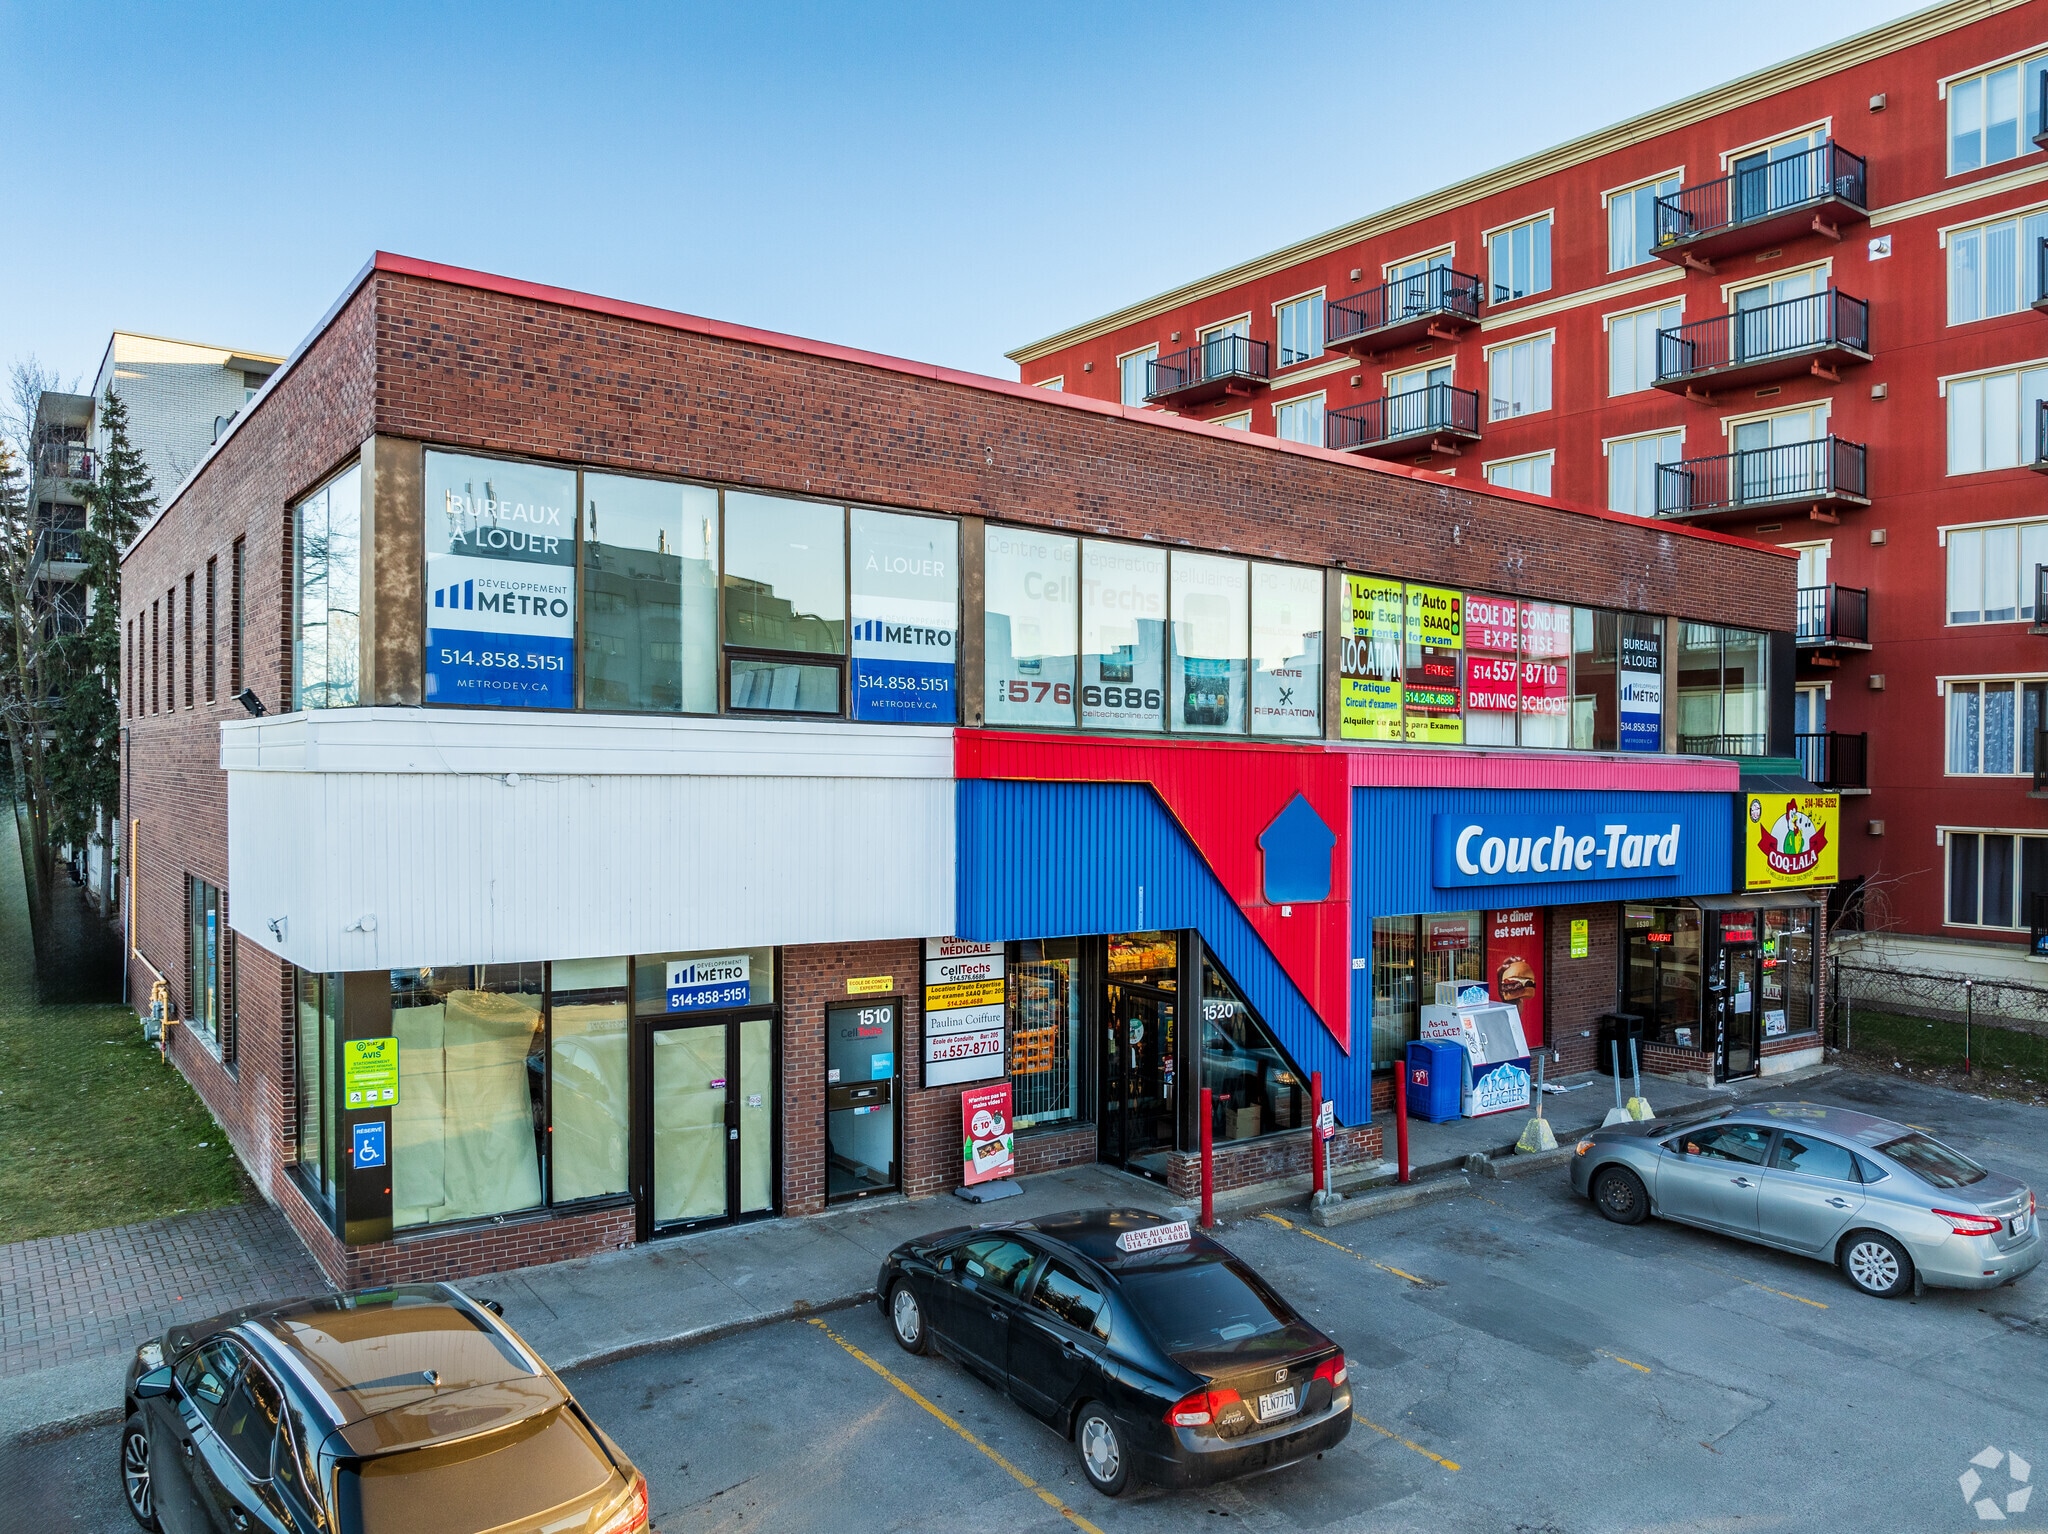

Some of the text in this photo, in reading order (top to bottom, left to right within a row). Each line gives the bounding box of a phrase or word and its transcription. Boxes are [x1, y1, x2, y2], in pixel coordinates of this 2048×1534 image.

[450, 495, 560, 527] BUREAUX
[450, 518, 559, 555] À LOUER
[865, 550, 945, 577] À LOUER
[987, 535, 1047, 559] Centre
[1054, 545, 1073, 562] de
[1083, 551, 1164, 574] réparation
[1173, 568, 1242, 589] cellulaires
[1290, 578, 1319, 594] MAC
[478, 578, 567, 594] DÉVELOPPEMENT
[478, 592, 569, 618] MÉTRO
[1413, 592, 1447, 611] d'Auto
[1352, 608, 1375, 622] pour
[1423, 615, 1450, 632] SAAQ
[1466, 597, 1570, 635] ÉCOLE DE CONDUITE
[886, 625, 952, 647] MÉTRO
[1352, 626, 1452, 646] car rental for exam
[1484, 629, 1554, 653] EXPERTISE
[1623, 638, 1658, 653] BUREAUX
[440, 648, 565, 671] 514.858.5151
[1341, 637, 1401, 679] LOCATION
[1624, 652, 1658, 669] À LOUER
[1270, 668, 1303, 678] VENTE
[1425, 663, 1455, 678] ERTISE
[1473, 660, 1558, 685] 514 557-8710
[457, 678, 549, 693] METRODEV.CA
[859, 674, 949, 692] 514.858.5151
[1352, 680, 1391, 695] Pratique
[1008, 680, 1071, 705] 576
[1082, 685, 1161, 710] 6686
[1345, 696, 1398, 711] Circuit d'examen
[1469, 691, 1567, 712] DRIVING SCHOOL
[1632, 688, 1660, 704] MÉTRO
[871, 700, 938, 710] METRODEV.CA
[1082, 709, 1160, 721] celltechsonline.com
[1343, 716, 1375, 730] Alquiler
[1411, 721, 1429, 731] para
[1430, 722, 1460, 732] Examen
[1620, 721, 1658, 734] 514.858.5151
[1390, 730, 1416, 739] SAAQ
[1455, 823, 1681, 876] Couche-Tard
[1768, 848, 1818, 873] COQ-LALA
[1496, 909, 1534, 924] Le dîner
[1494, 924, 1536, 939] est servi.
[1636, 920, 1650, 932] 1530
[1647, 933, 1673, 943] OUVERT
[940, 943, 991, 956] MÉDICALE
[696, 959, 742, 969] DÉVELOPPEMENT
[940, 962, 991, 976] CellTechs
[697, 966, 743, 982] MÉTRO
[931, 984, 956, 993] Location
[975, 981, 1002, 990] Expertise
[671, 986, 747, 1008] 514-858-5151
[927, 994, 941, 1002] pour
[942, 992, 965, 1000] examen
[857, 1008, 891, 1025] 1510
[931, 1012, 1001, 1029] Paulina Coiffure
[1203, 1003, 1234, 1021] 1520
[841, 1027, 883, 1038] CellTechs
[1421, 1026, 1461, 1039] TA GLACE?
[1428, 1020, 1449, 1028] As-tu
[953, 1034, 974, 1042] Conduite
[990, 1031, 999, 1039] 205
[362, 1051, 381, 1059] AVIS
[933, 1039, 1000, 1060] 514 557-8710
[1481, 1069, 1525, 1095] ARCTIC
[1481, 1087, 1525, 1108] GLACIER
[1125, 1223, 1187, 1242] ÉLÈVE AU VOLANT
[1126, 1231, 1189, 1250] 514-246-4688
[1262, 1392, 1294, 1413] FLN7770
